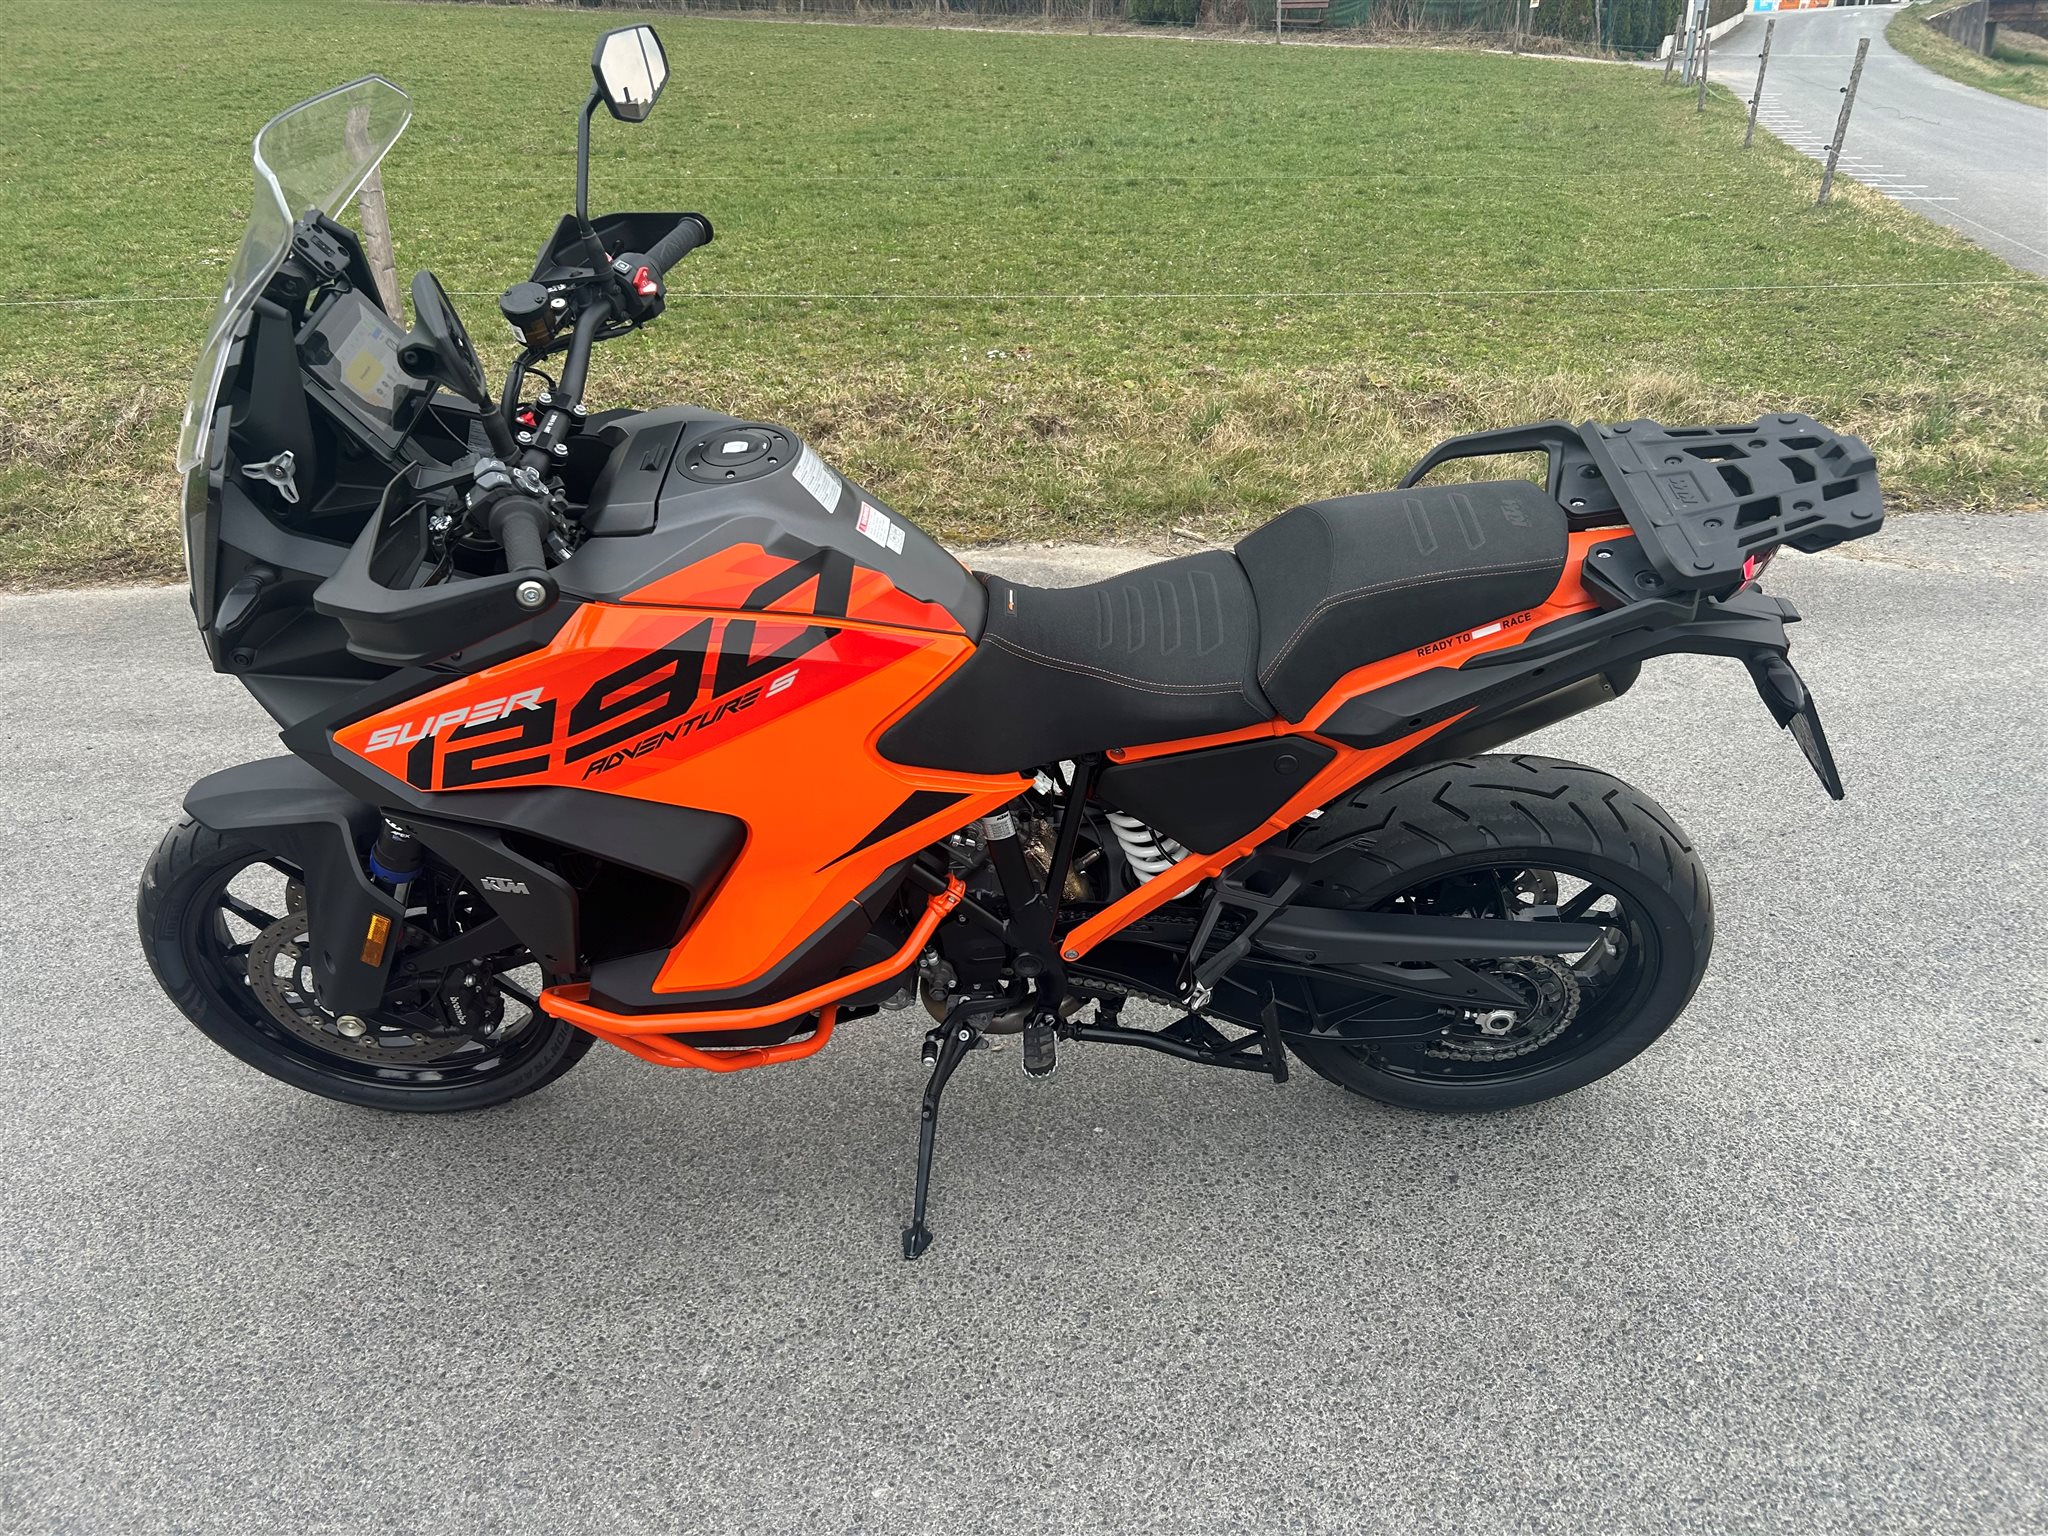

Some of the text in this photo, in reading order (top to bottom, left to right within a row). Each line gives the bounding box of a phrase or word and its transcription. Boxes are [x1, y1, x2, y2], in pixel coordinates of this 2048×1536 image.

[1416, 612, 1532, 658] READY TO RACE
[364, 686, 545, 754] SUPER
[581, 668, 800, 782] ADVENTURE S
[480, 876, 530, 895] KTM
[449, 996, 467, 1025] brembo
